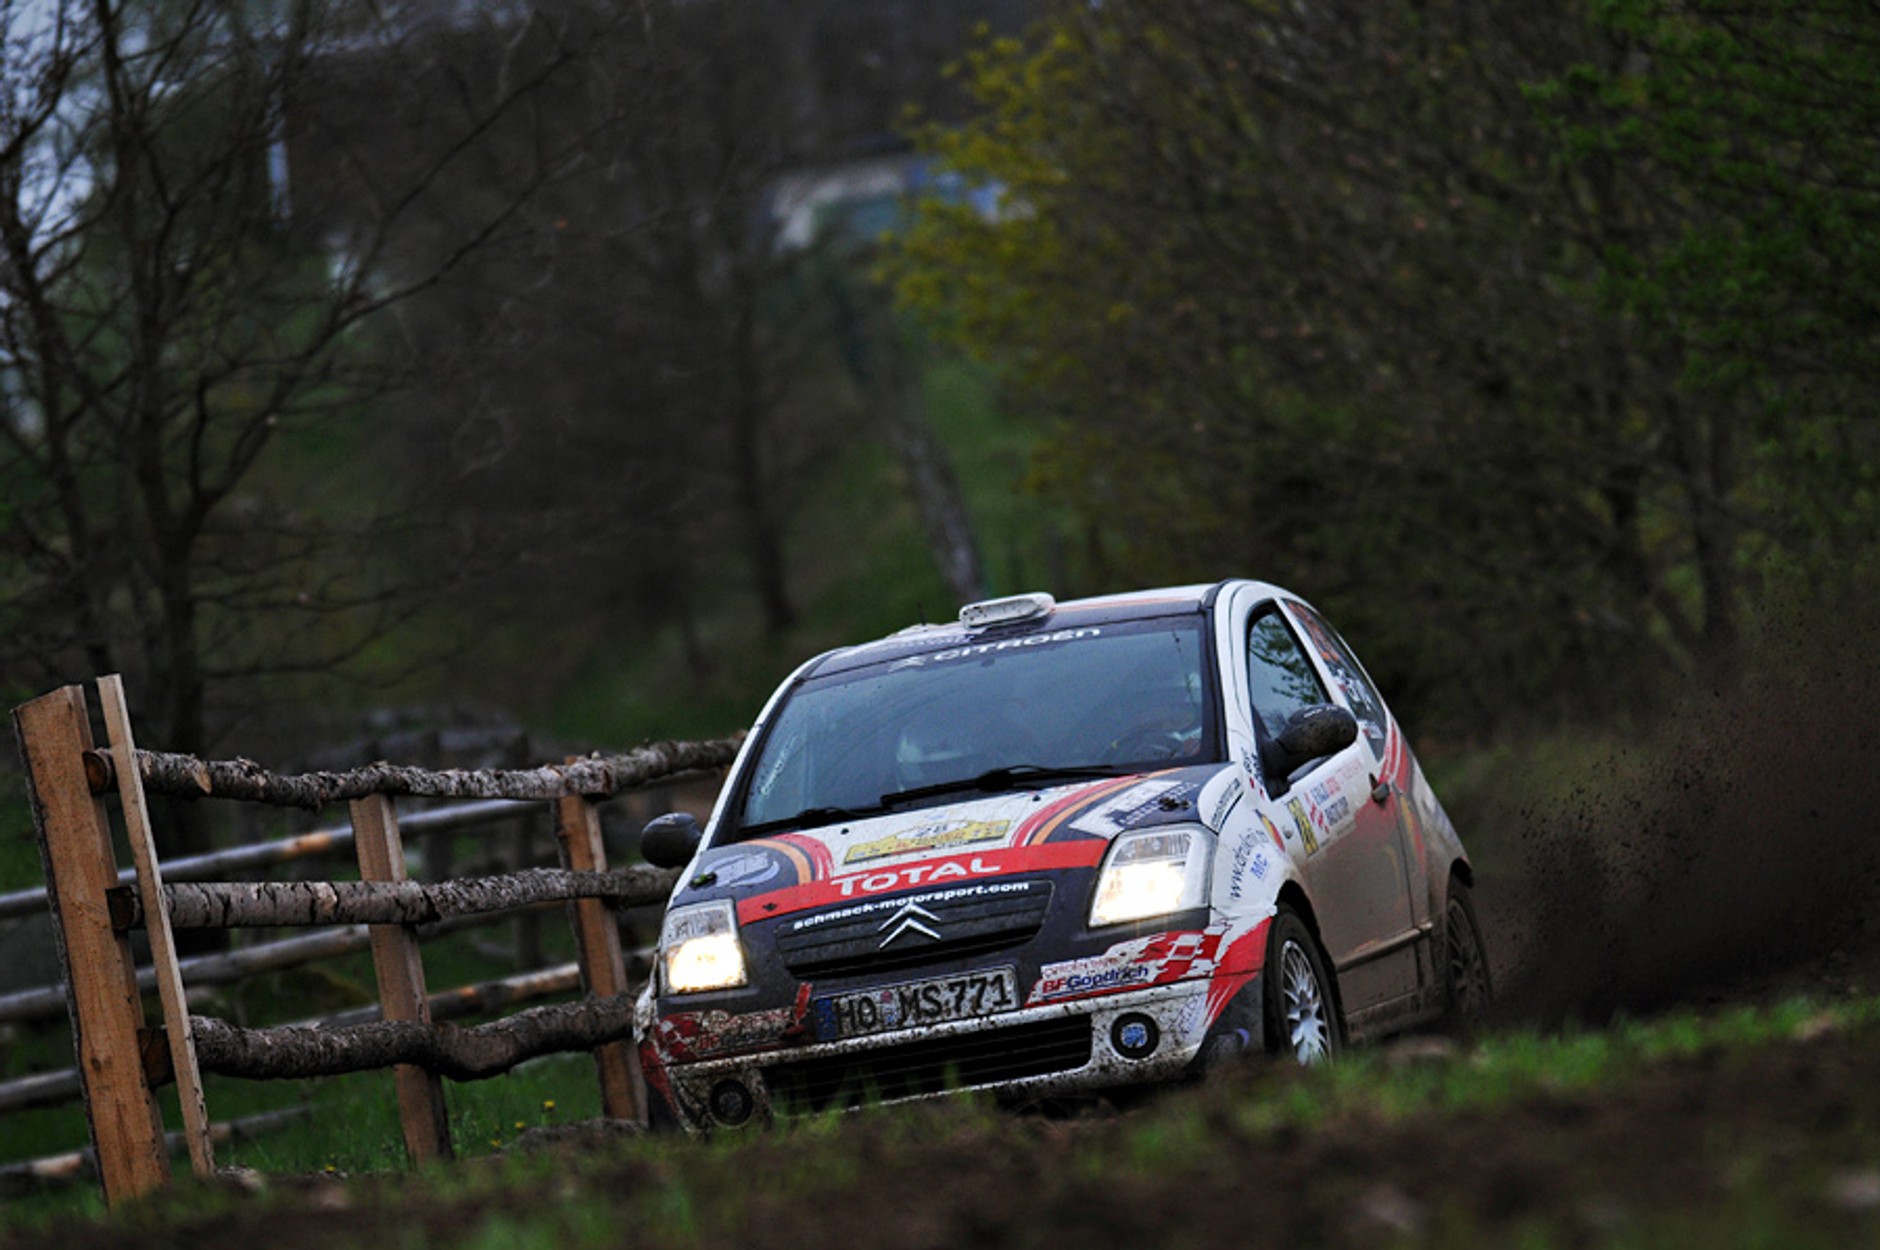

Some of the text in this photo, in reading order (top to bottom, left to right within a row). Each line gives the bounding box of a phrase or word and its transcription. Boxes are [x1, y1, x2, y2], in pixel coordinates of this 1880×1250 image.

[831, 858, 1001, 897] TOTAL
[793, 881, 1029, 931] schmack-motorsport.com
[836, 996, 877, 1036] HO
[899, 985, 942, 1029] MS
[948, 975, 1008, 1016] 771
